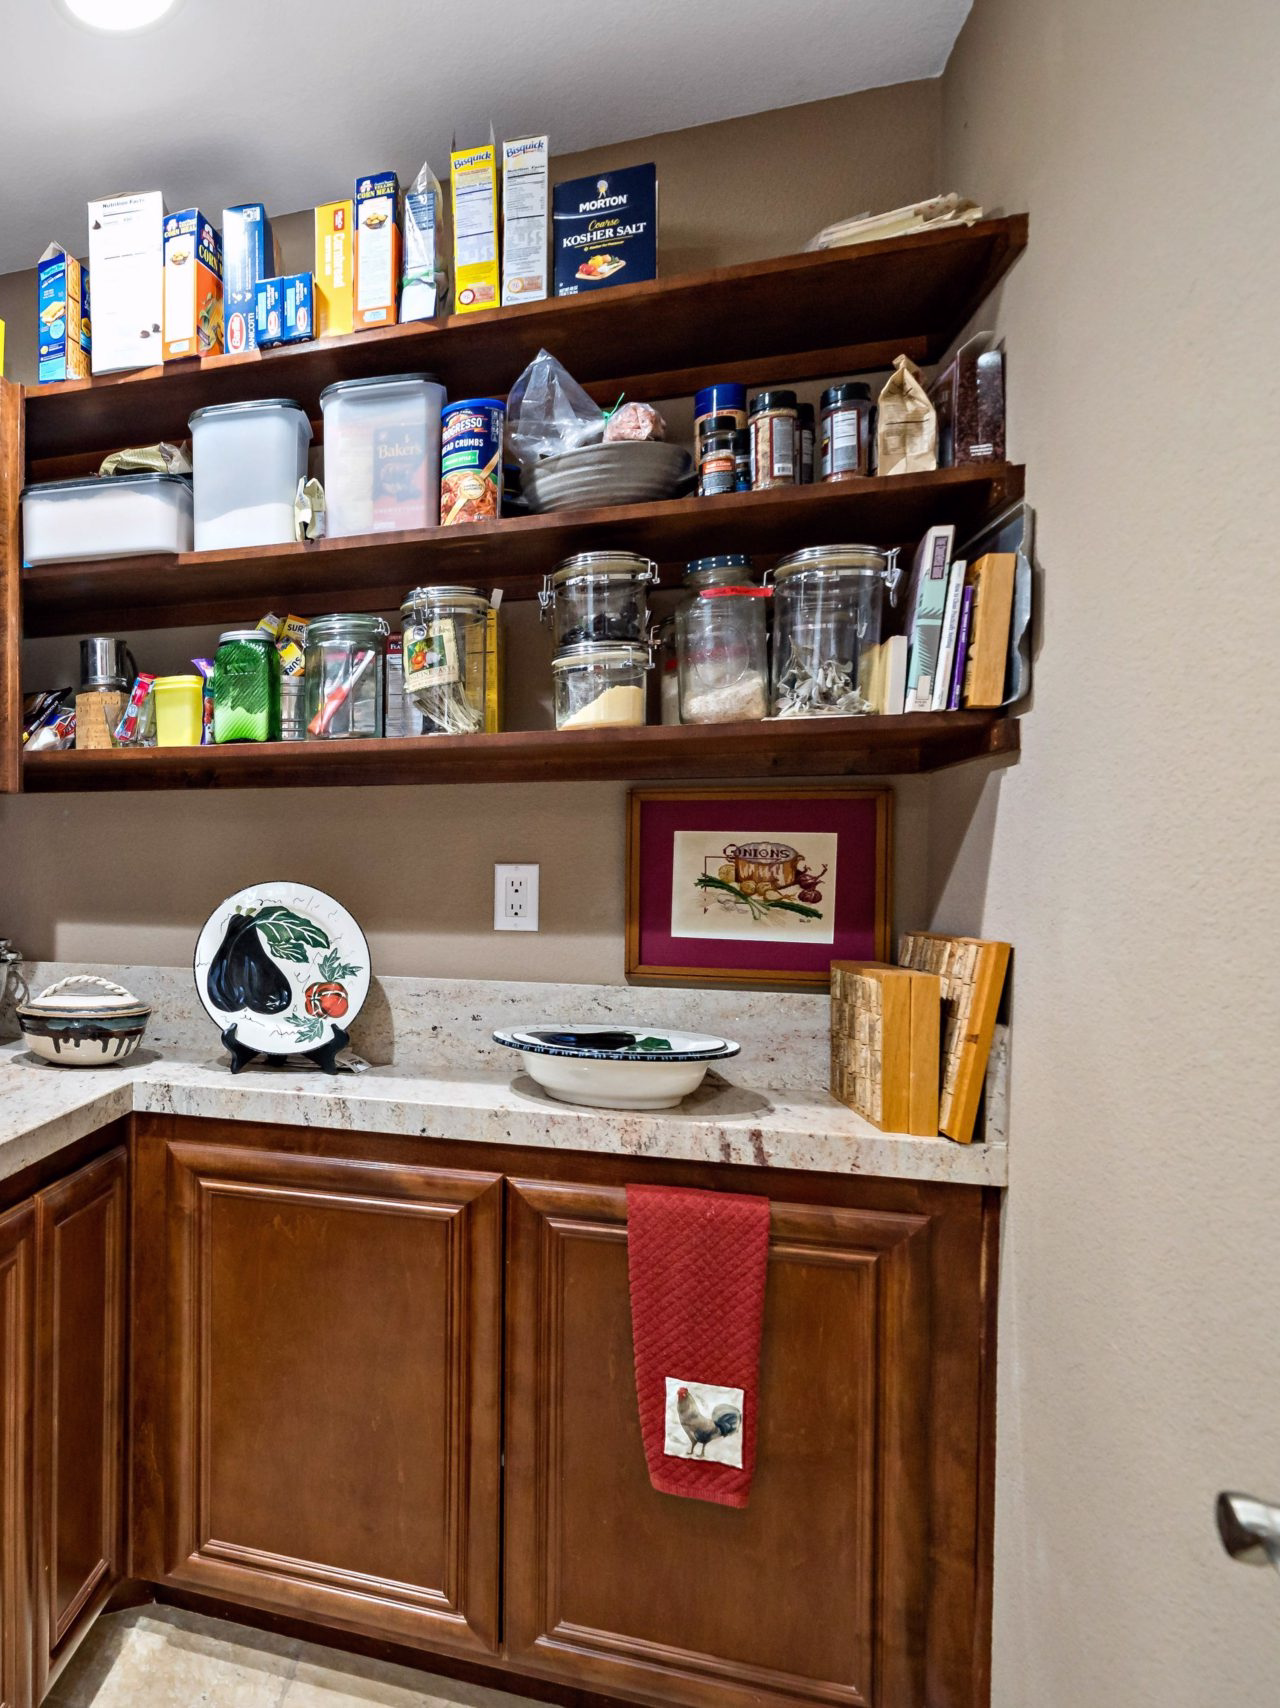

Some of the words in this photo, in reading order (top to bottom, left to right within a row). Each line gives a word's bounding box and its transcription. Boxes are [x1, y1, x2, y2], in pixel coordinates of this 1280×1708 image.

[506, 140, 544, 158] Bisquick
[454, 151, 491, 170] Bisquick
[358, 190, 375, 200] CORN
[376, 186, 395, 196] MEAL
[579, 194, 628, 213] MORTON
[588, 218, 620, 232] Coarse
[563, 227, 614, 248] KOSHER
[616, 222, 647, 237] SALT
[199, 244, 219, 271] CORN
[231, 314, 241, 347] Barilla
[455, 438, 484, 449] CRUMBS
